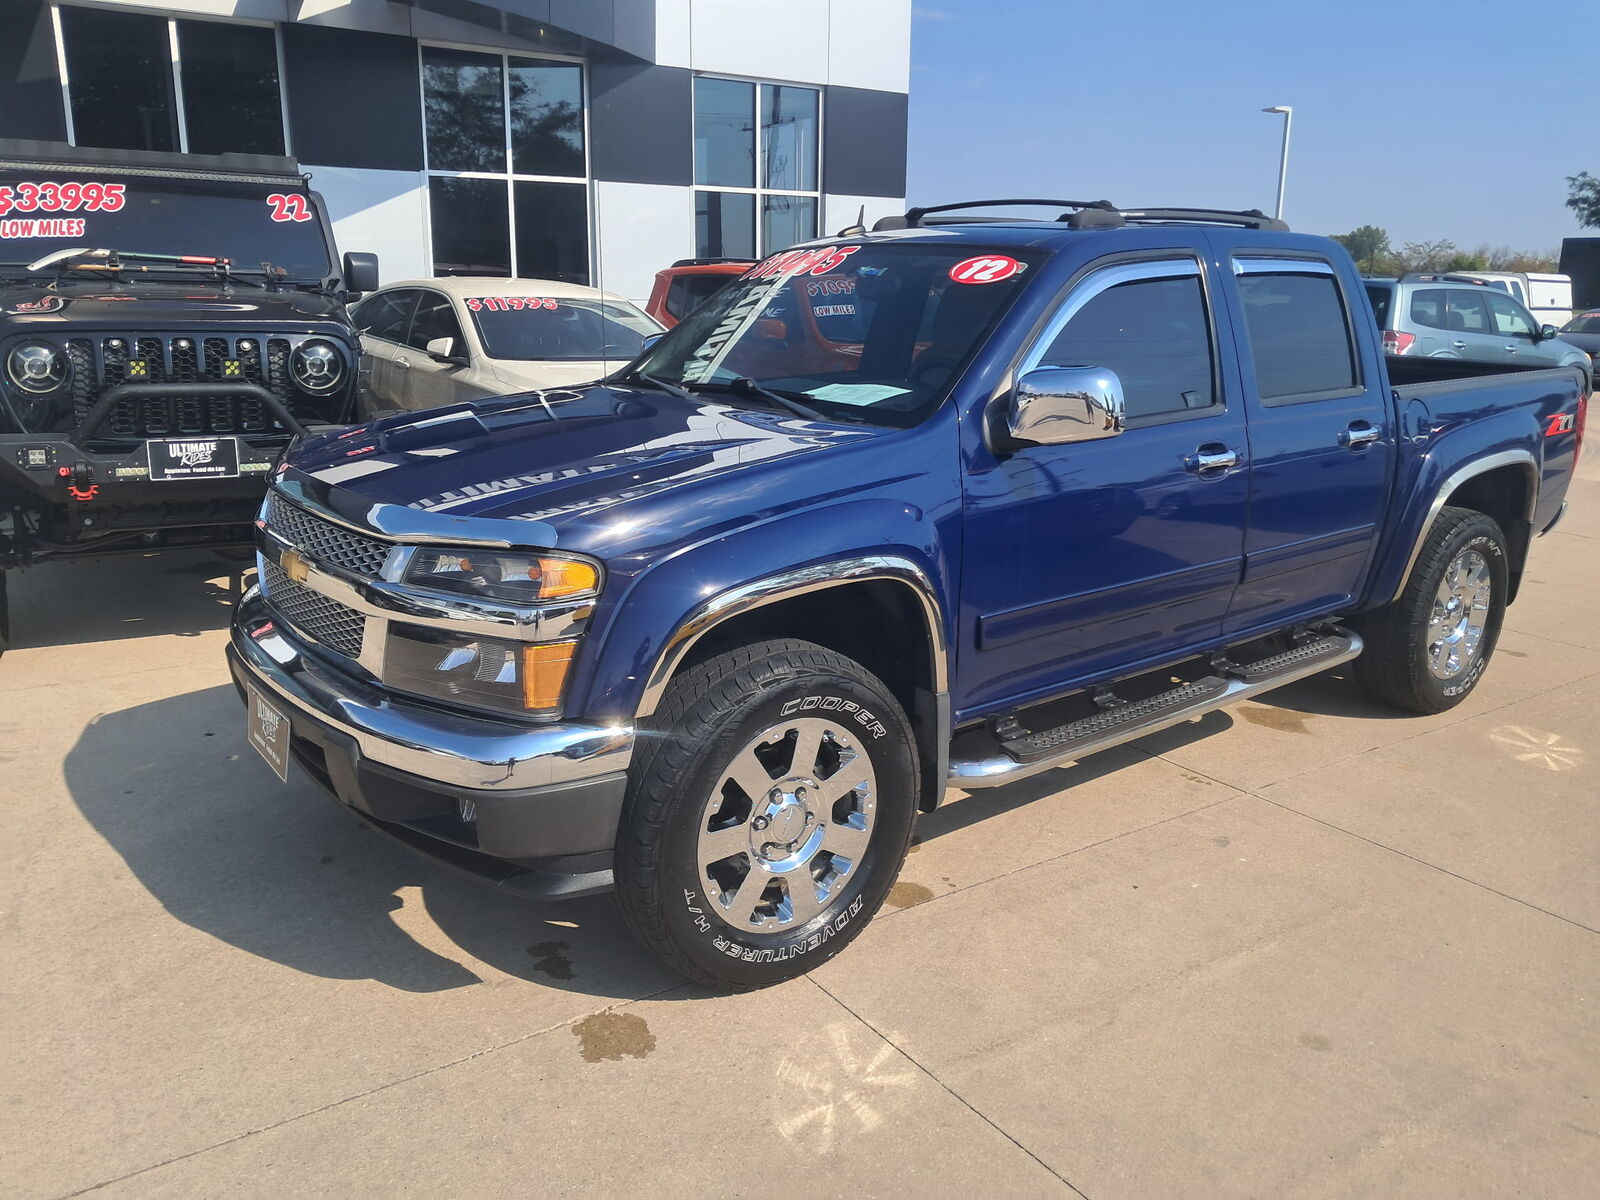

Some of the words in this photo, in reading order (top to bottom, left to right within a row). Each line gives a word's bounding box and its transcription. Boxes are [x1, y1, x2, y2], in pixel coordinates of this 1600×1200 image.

[0, 182, 125, 216] $33995
[266, 194, 312, 222] 22
[0, 219, 34, 238] LOW
[37, 218, 85, 237] MILES
[957, 259, 1009, 281] 12
[467, 297, 558, 311] $11995
[813, 306, 830, 317] LOW
[831, 305, 855, 315] MILES
[1545, 413, 1574, 436] Z71
[169, 442, 217, 458] ULTIMATE
[780, 696, 887, 740] COOPER
[684, 888, 711, 934] H/T
[713, 894, 863, 963] ADVENTURER
